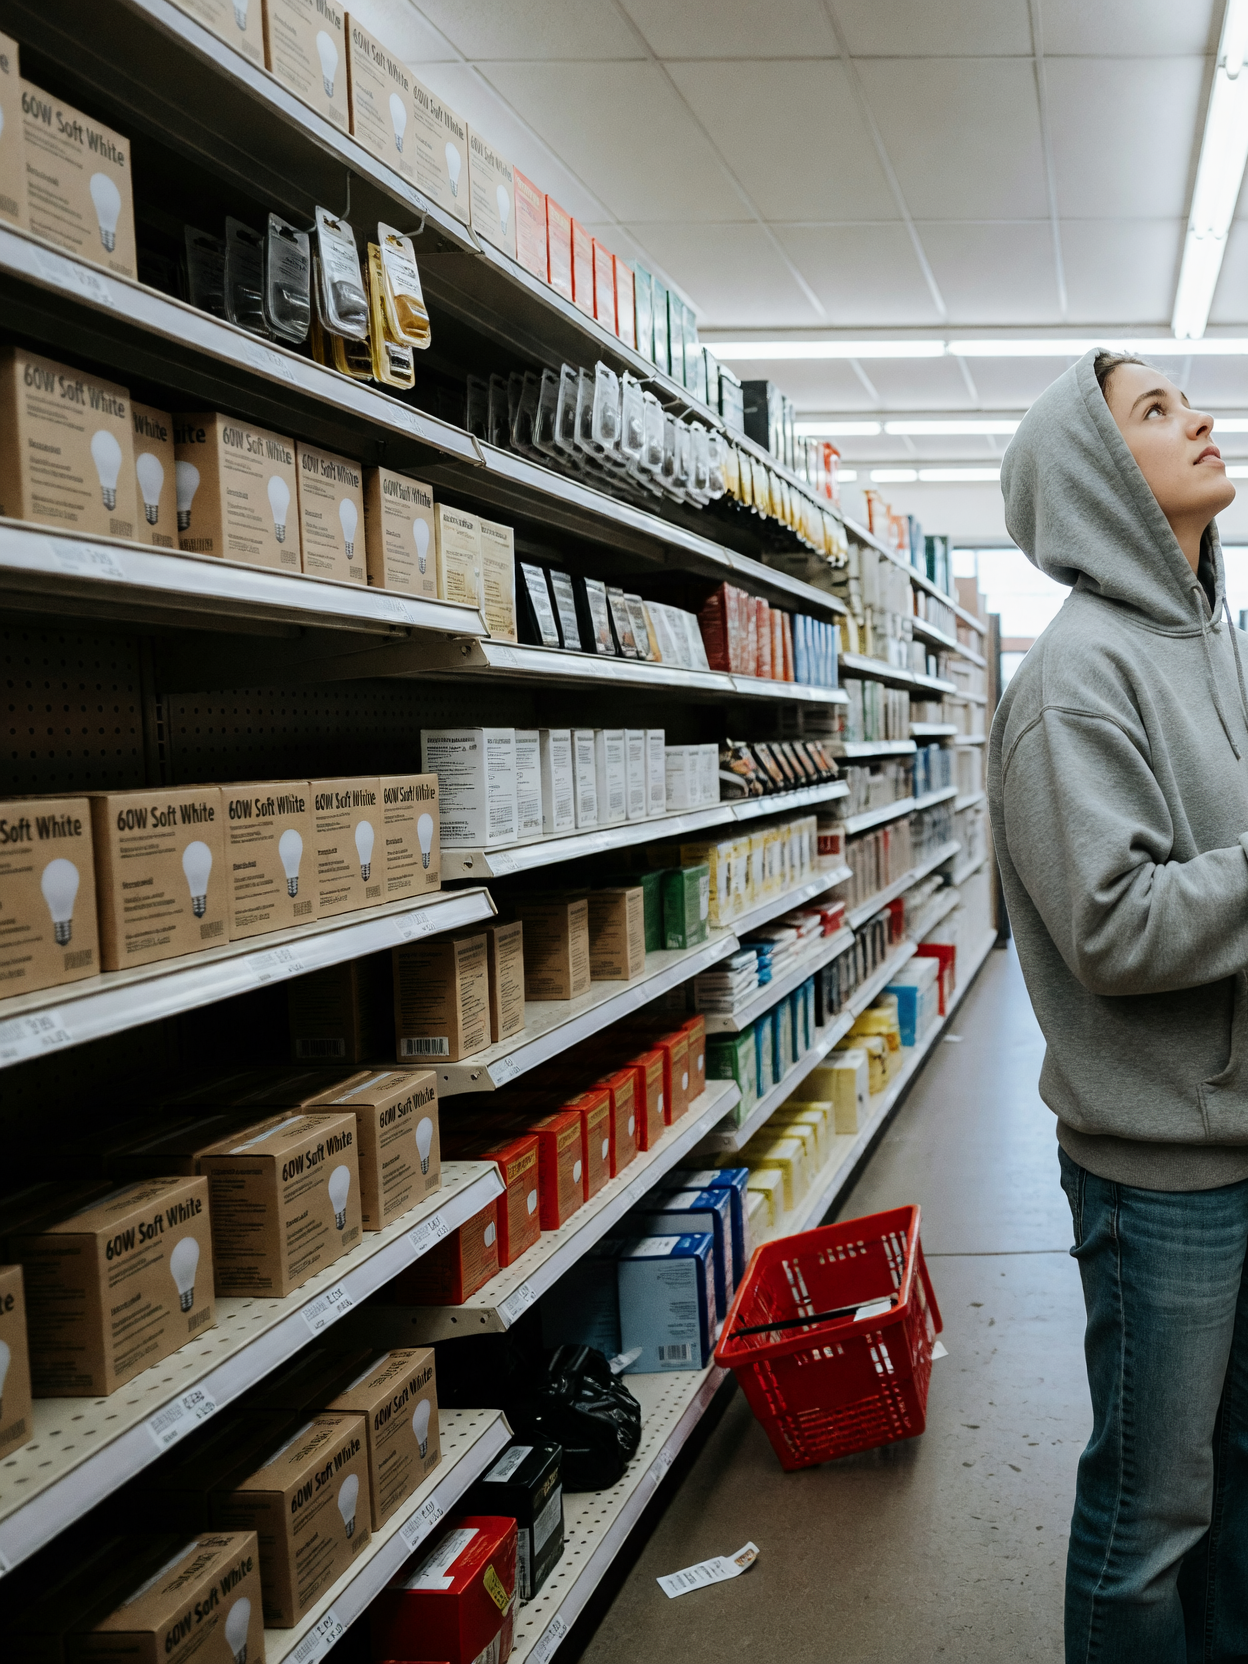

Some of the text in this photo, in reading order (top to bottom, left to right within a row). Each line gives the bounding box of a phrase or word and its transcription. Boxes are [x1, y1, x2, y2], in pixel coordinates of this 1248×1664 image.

[21, 91, 52, 126] 60W
[56, 114, 84, 147] Soft
[86, 127, 125, 168] White
[24, 363, 125, 419] 60W Soft White
[133, 412, 168, 442] White
[222, 426, 293, 466] 60W Soft White
[35, 814, 82, 840] White
[117, 802, 215, 832] 60W Soft White
[229, 793, 306, 820] 60W Soft White
[282, 1131, 353, 1183] 60W Soft White
[106, 1198, 203, 1261] 60W Soft White
[291, 1437, 361, 1514] 60W Soft White
[165, 1556, 253, 1653] 60W Soft White
